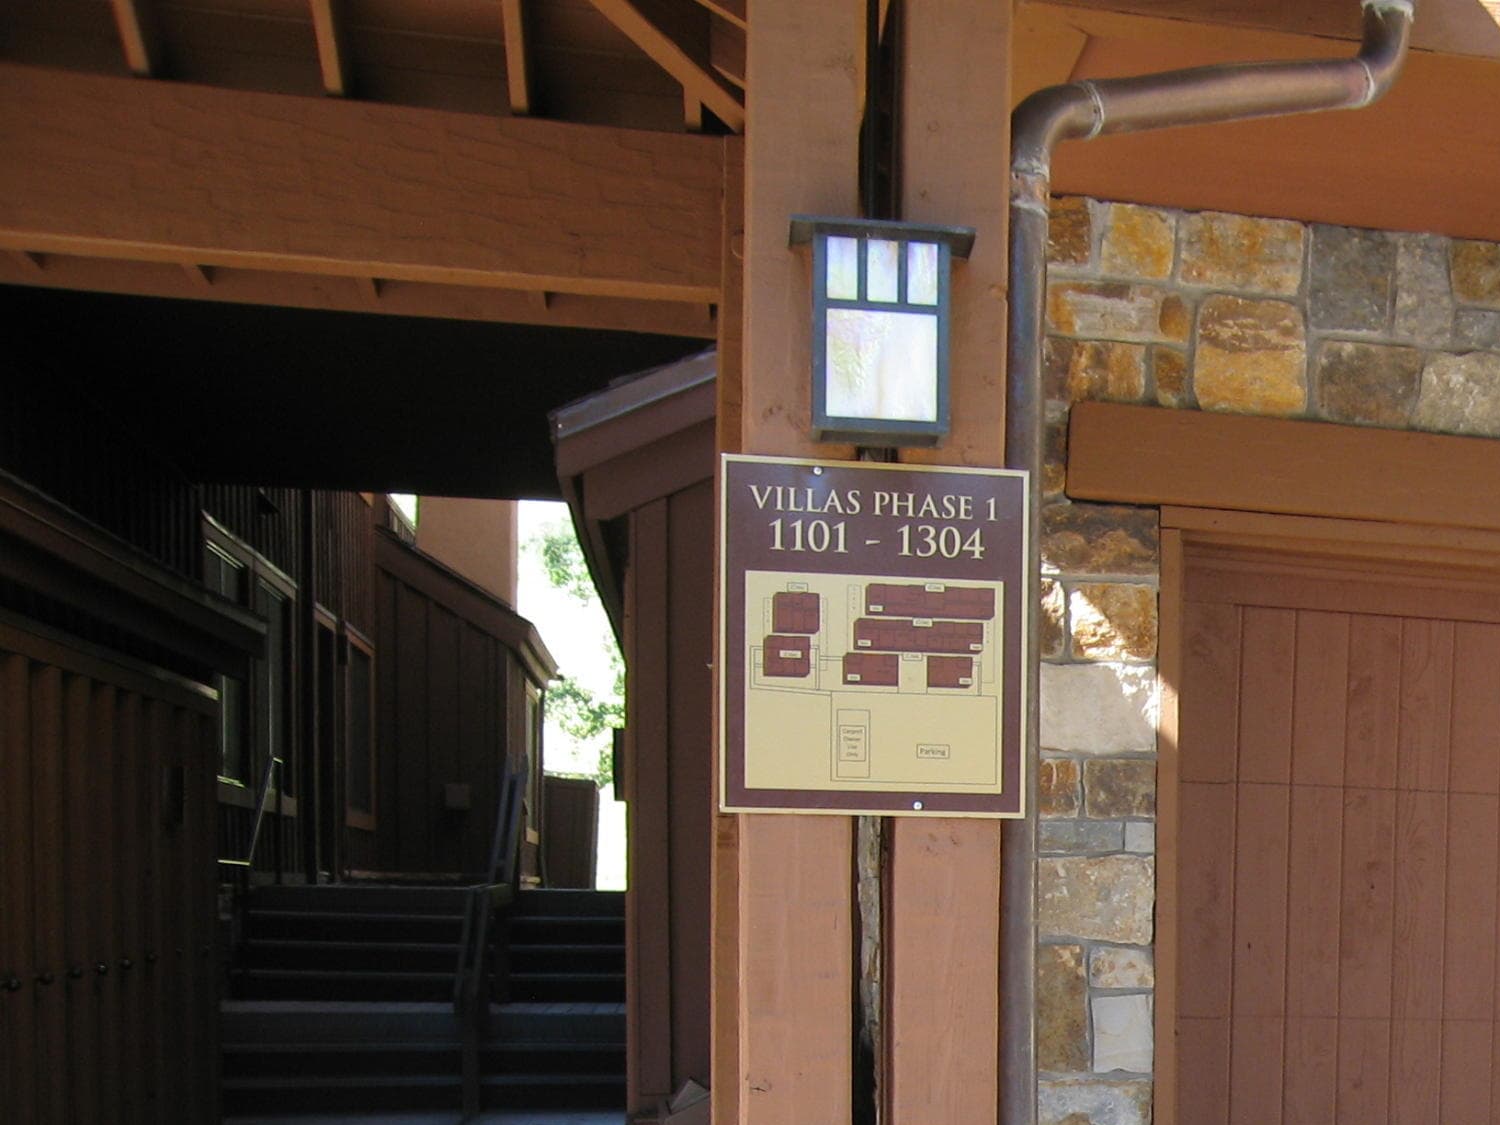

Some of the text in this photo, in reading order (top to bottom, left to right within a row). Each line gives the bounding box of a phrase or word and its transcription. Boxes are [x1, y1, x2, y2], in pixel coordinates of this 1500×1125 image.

[748, 484, 998, 521] VILLAS PHASE 1
[768, 519, 849, 554] 1101
[897, 525, 986, 560] 1304
[919, 747, 946, 757] Parking
